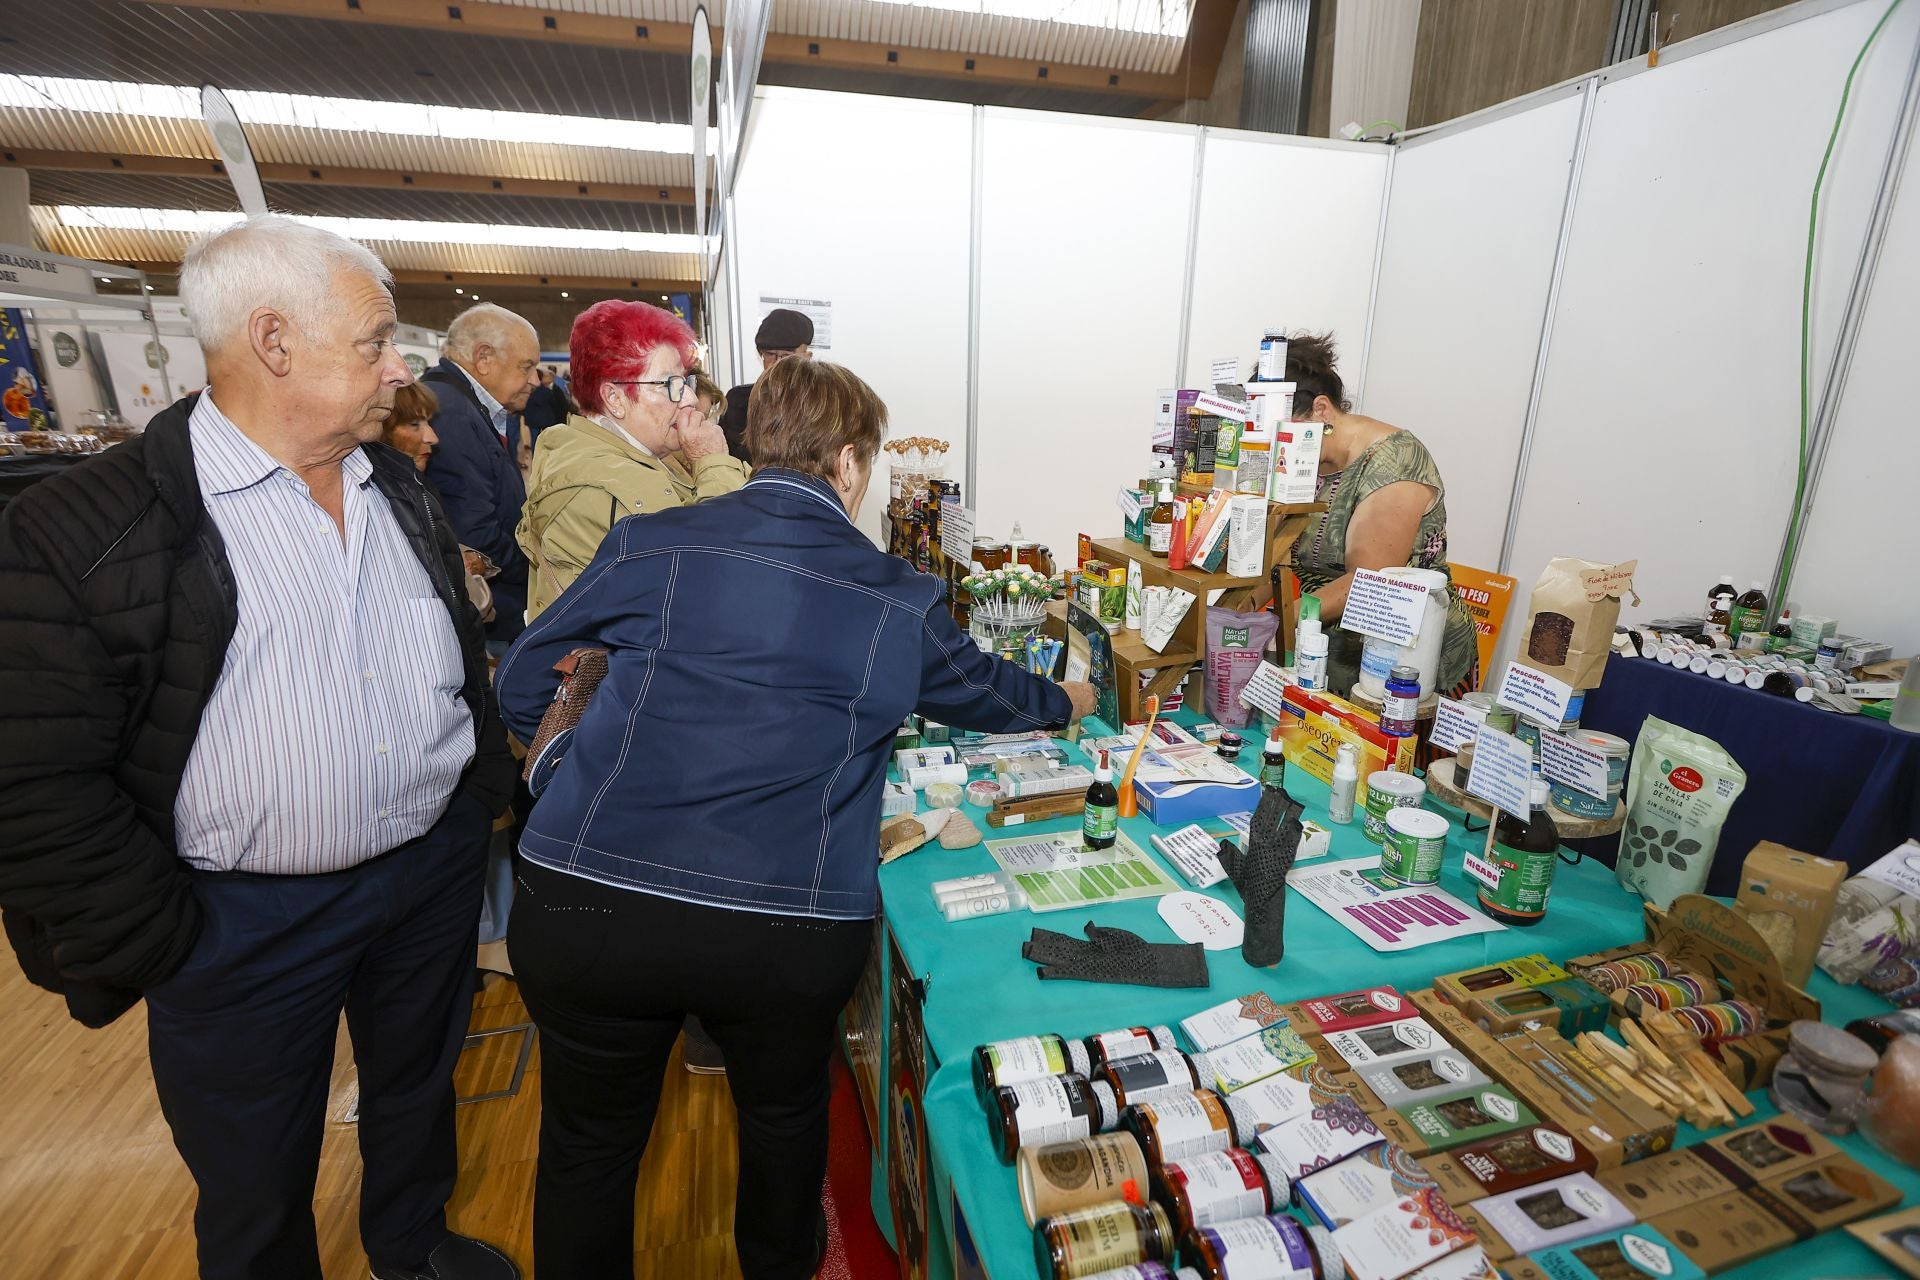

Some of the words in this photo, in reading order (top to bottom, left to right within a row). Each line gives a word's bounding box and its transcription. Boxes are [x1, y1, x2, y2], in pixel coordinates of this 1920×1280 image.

[45, 262, 59, 274] DE
[1352, 585, 1369, 593] Reducir
[1356, 572, 1387, 584] CLORURO
[1388, 579, 1427, 593] MAGNESIO
[1467, 588, 1490, 604] PESO
[1387, 612, 1407, 622] Cerebro
[1217, 651, 1232, 705] HIMALAYA
[1511, 667, 1545, 684] Pescados
[1507, 681, 1541, 698] Lemongrass,
[1440, 702, 1465, 716] Ensaladas
[1504, 694, 1535, 710] Agricultura
[1542, 732, 1565, 746] Hierbas
[1566, 742, 1604, 762] Provenzales
[1544, 767, 1572, 784] Agricultura
[1673, 772, 1700, 788] Granero
[1653, 789, 1663, 798] DE
[1665, 795, 1683, 808] CHÍA
[1654, 781, 1691, 801] SEMILLAS
[1580, 801, 1595, 810] Sal
[1647, 800, 1657, 808] SIN
[1659, 806, 1682, 820] GLUTEN
[1466, 858, 1498, 882] HIGADO
[1887, 868, 1920, 888] LAVAN
[1402, 1026, 1423, 1046] Madre
[1336, 1033, 1369, 1062] INCIENSO
